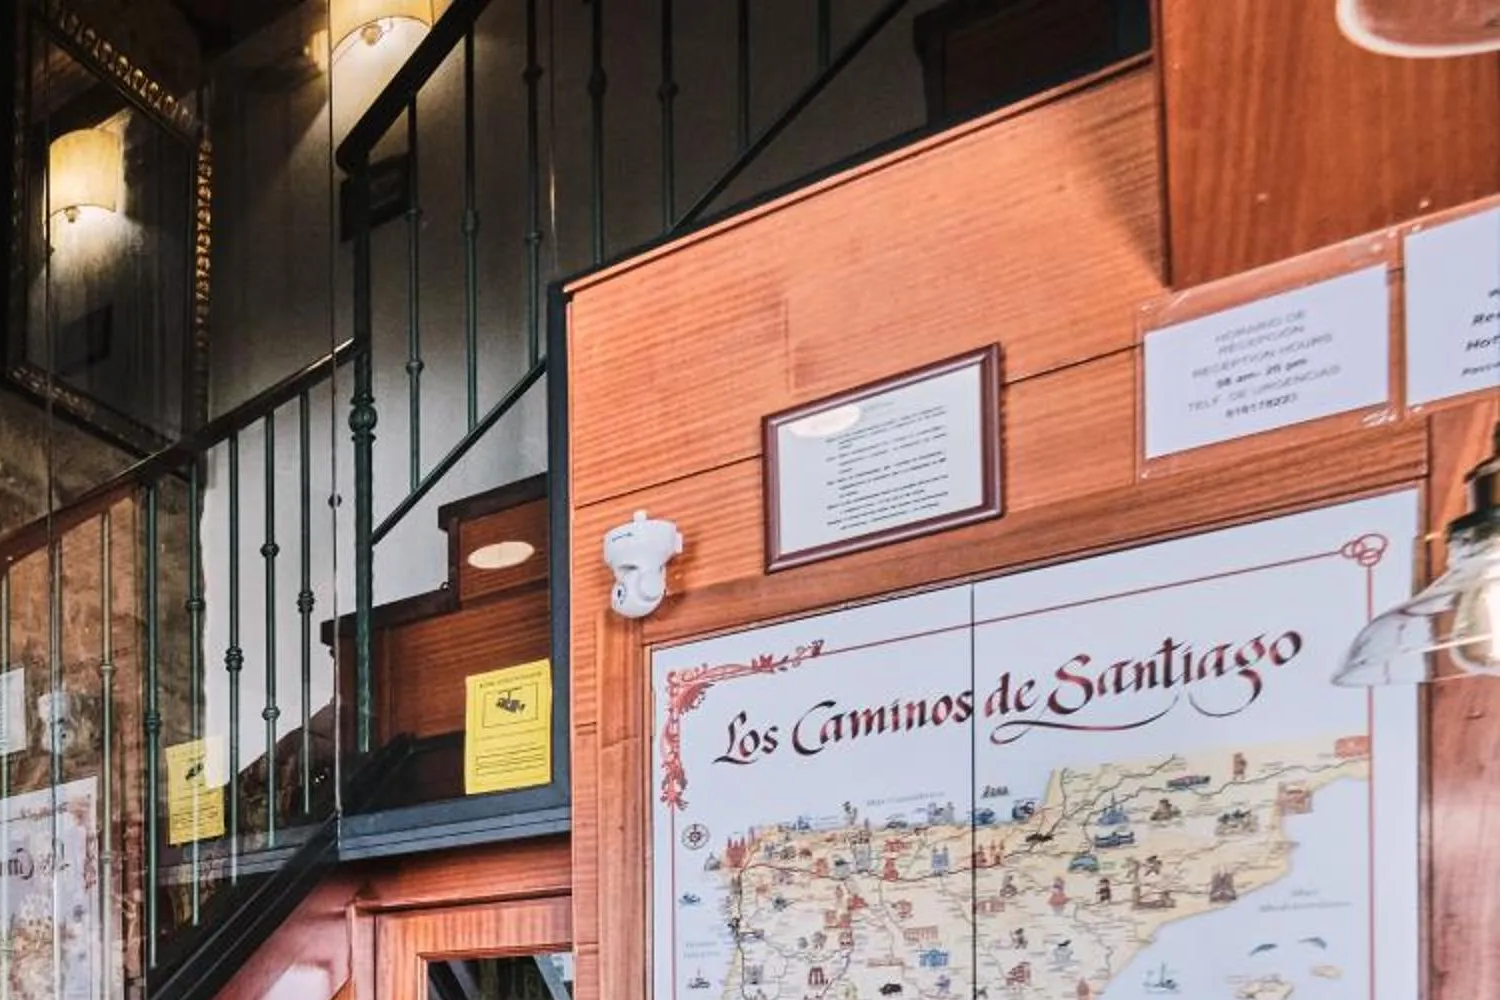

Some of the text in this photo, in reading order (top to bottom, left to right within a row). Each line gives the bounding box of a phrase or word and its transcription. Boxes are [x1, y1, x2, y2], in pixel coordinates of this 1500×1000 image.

[712, 630, 1304, 765] Los Caminos de Santiago
